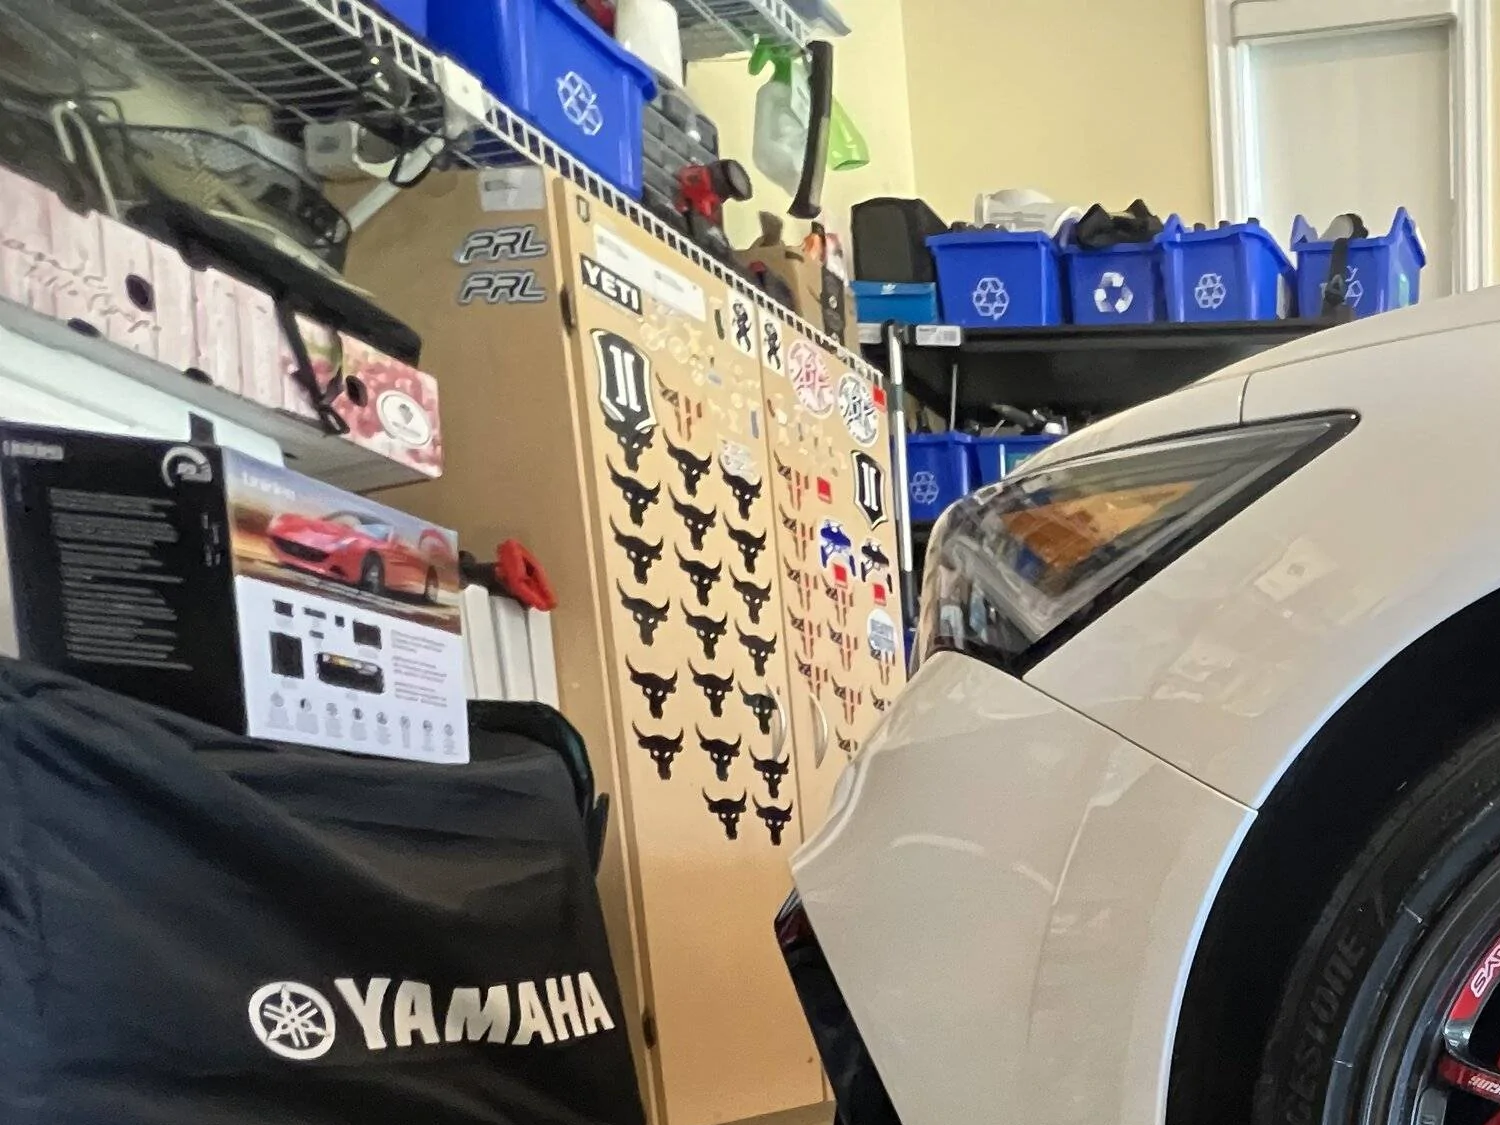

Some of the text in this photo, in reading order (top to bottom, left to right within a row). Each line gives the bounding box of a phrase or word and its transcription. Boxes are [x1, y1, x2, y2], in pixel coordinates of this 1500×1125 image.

[460, 225, 547, 262] PRL
[459, 270, 547, 303] PRL
[583, 259, 640, 311] YETI
[335, 971, 615, 1050] YAMAHA
